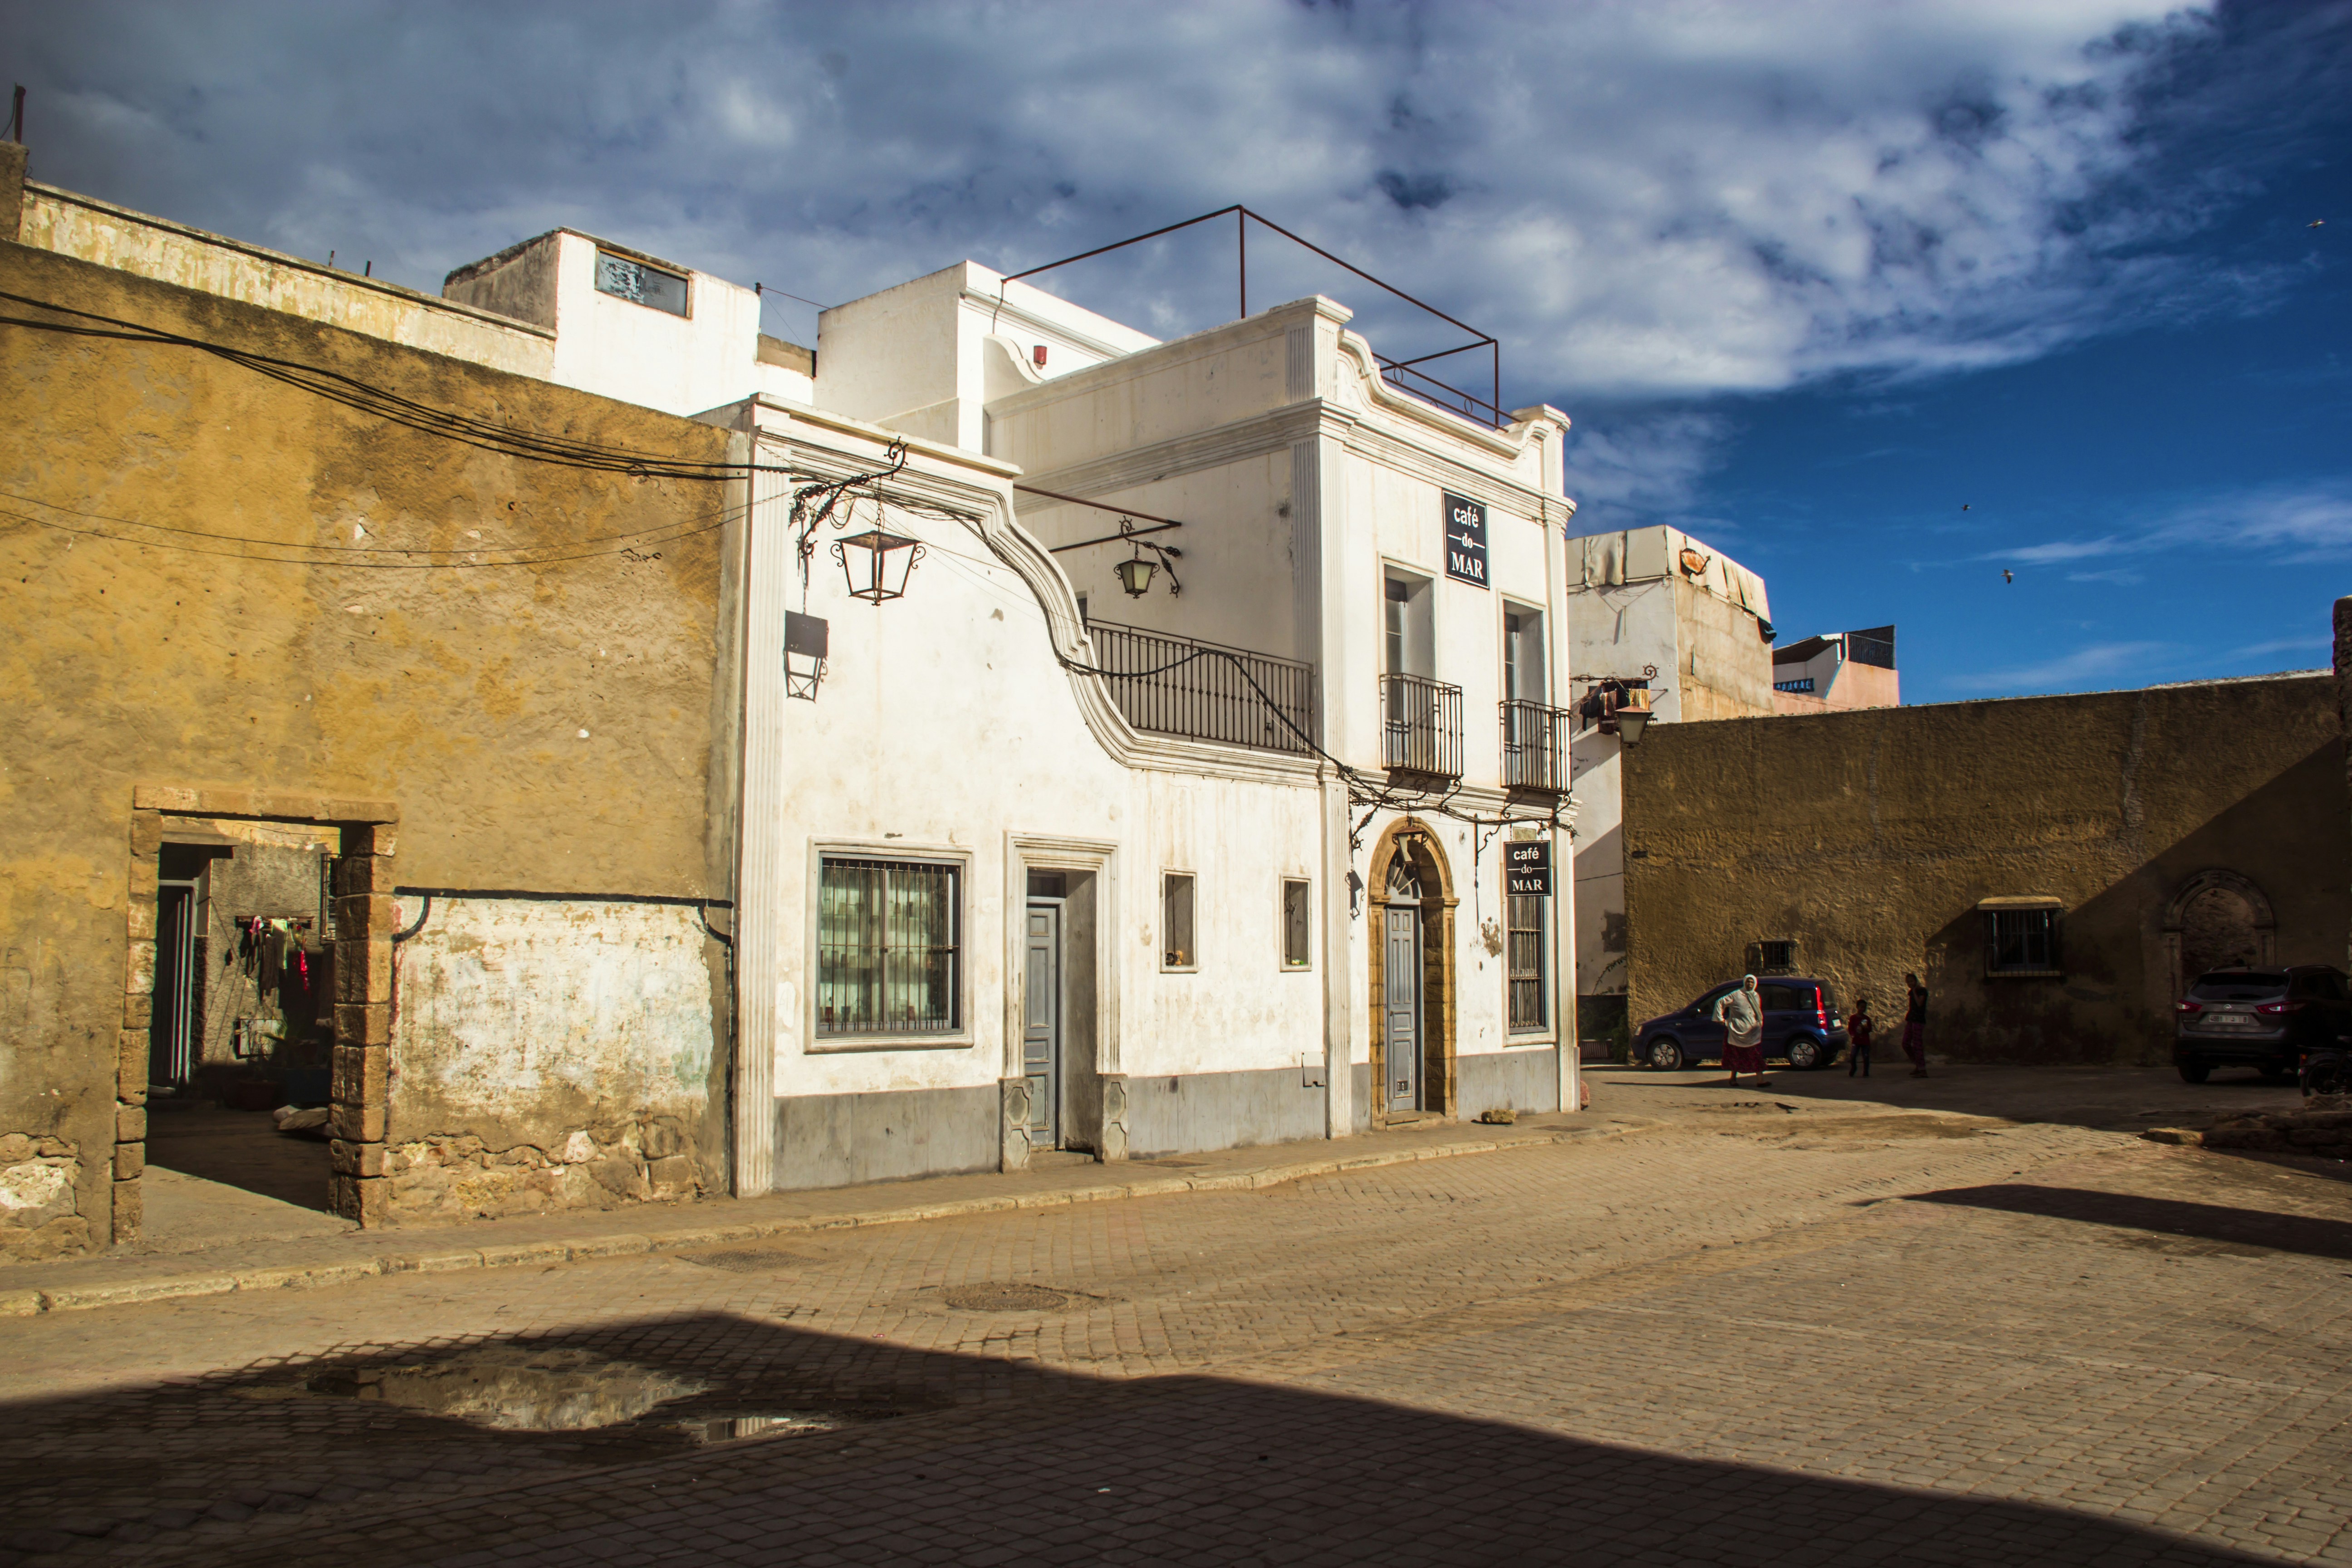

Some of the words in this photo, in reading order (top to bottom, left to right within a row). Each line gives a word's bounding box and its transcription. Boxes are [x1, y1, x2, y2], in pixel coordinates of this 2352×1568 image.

[1454, 505, 1479, 528] café
[1462, 533, 1473, 549] do
[1451, 552, 1484, 579] MAR
[1514, 847, 1539, 860] café
[1521, 864, 1532, 873] do
[1512, 879, 1543, 891] MAR
